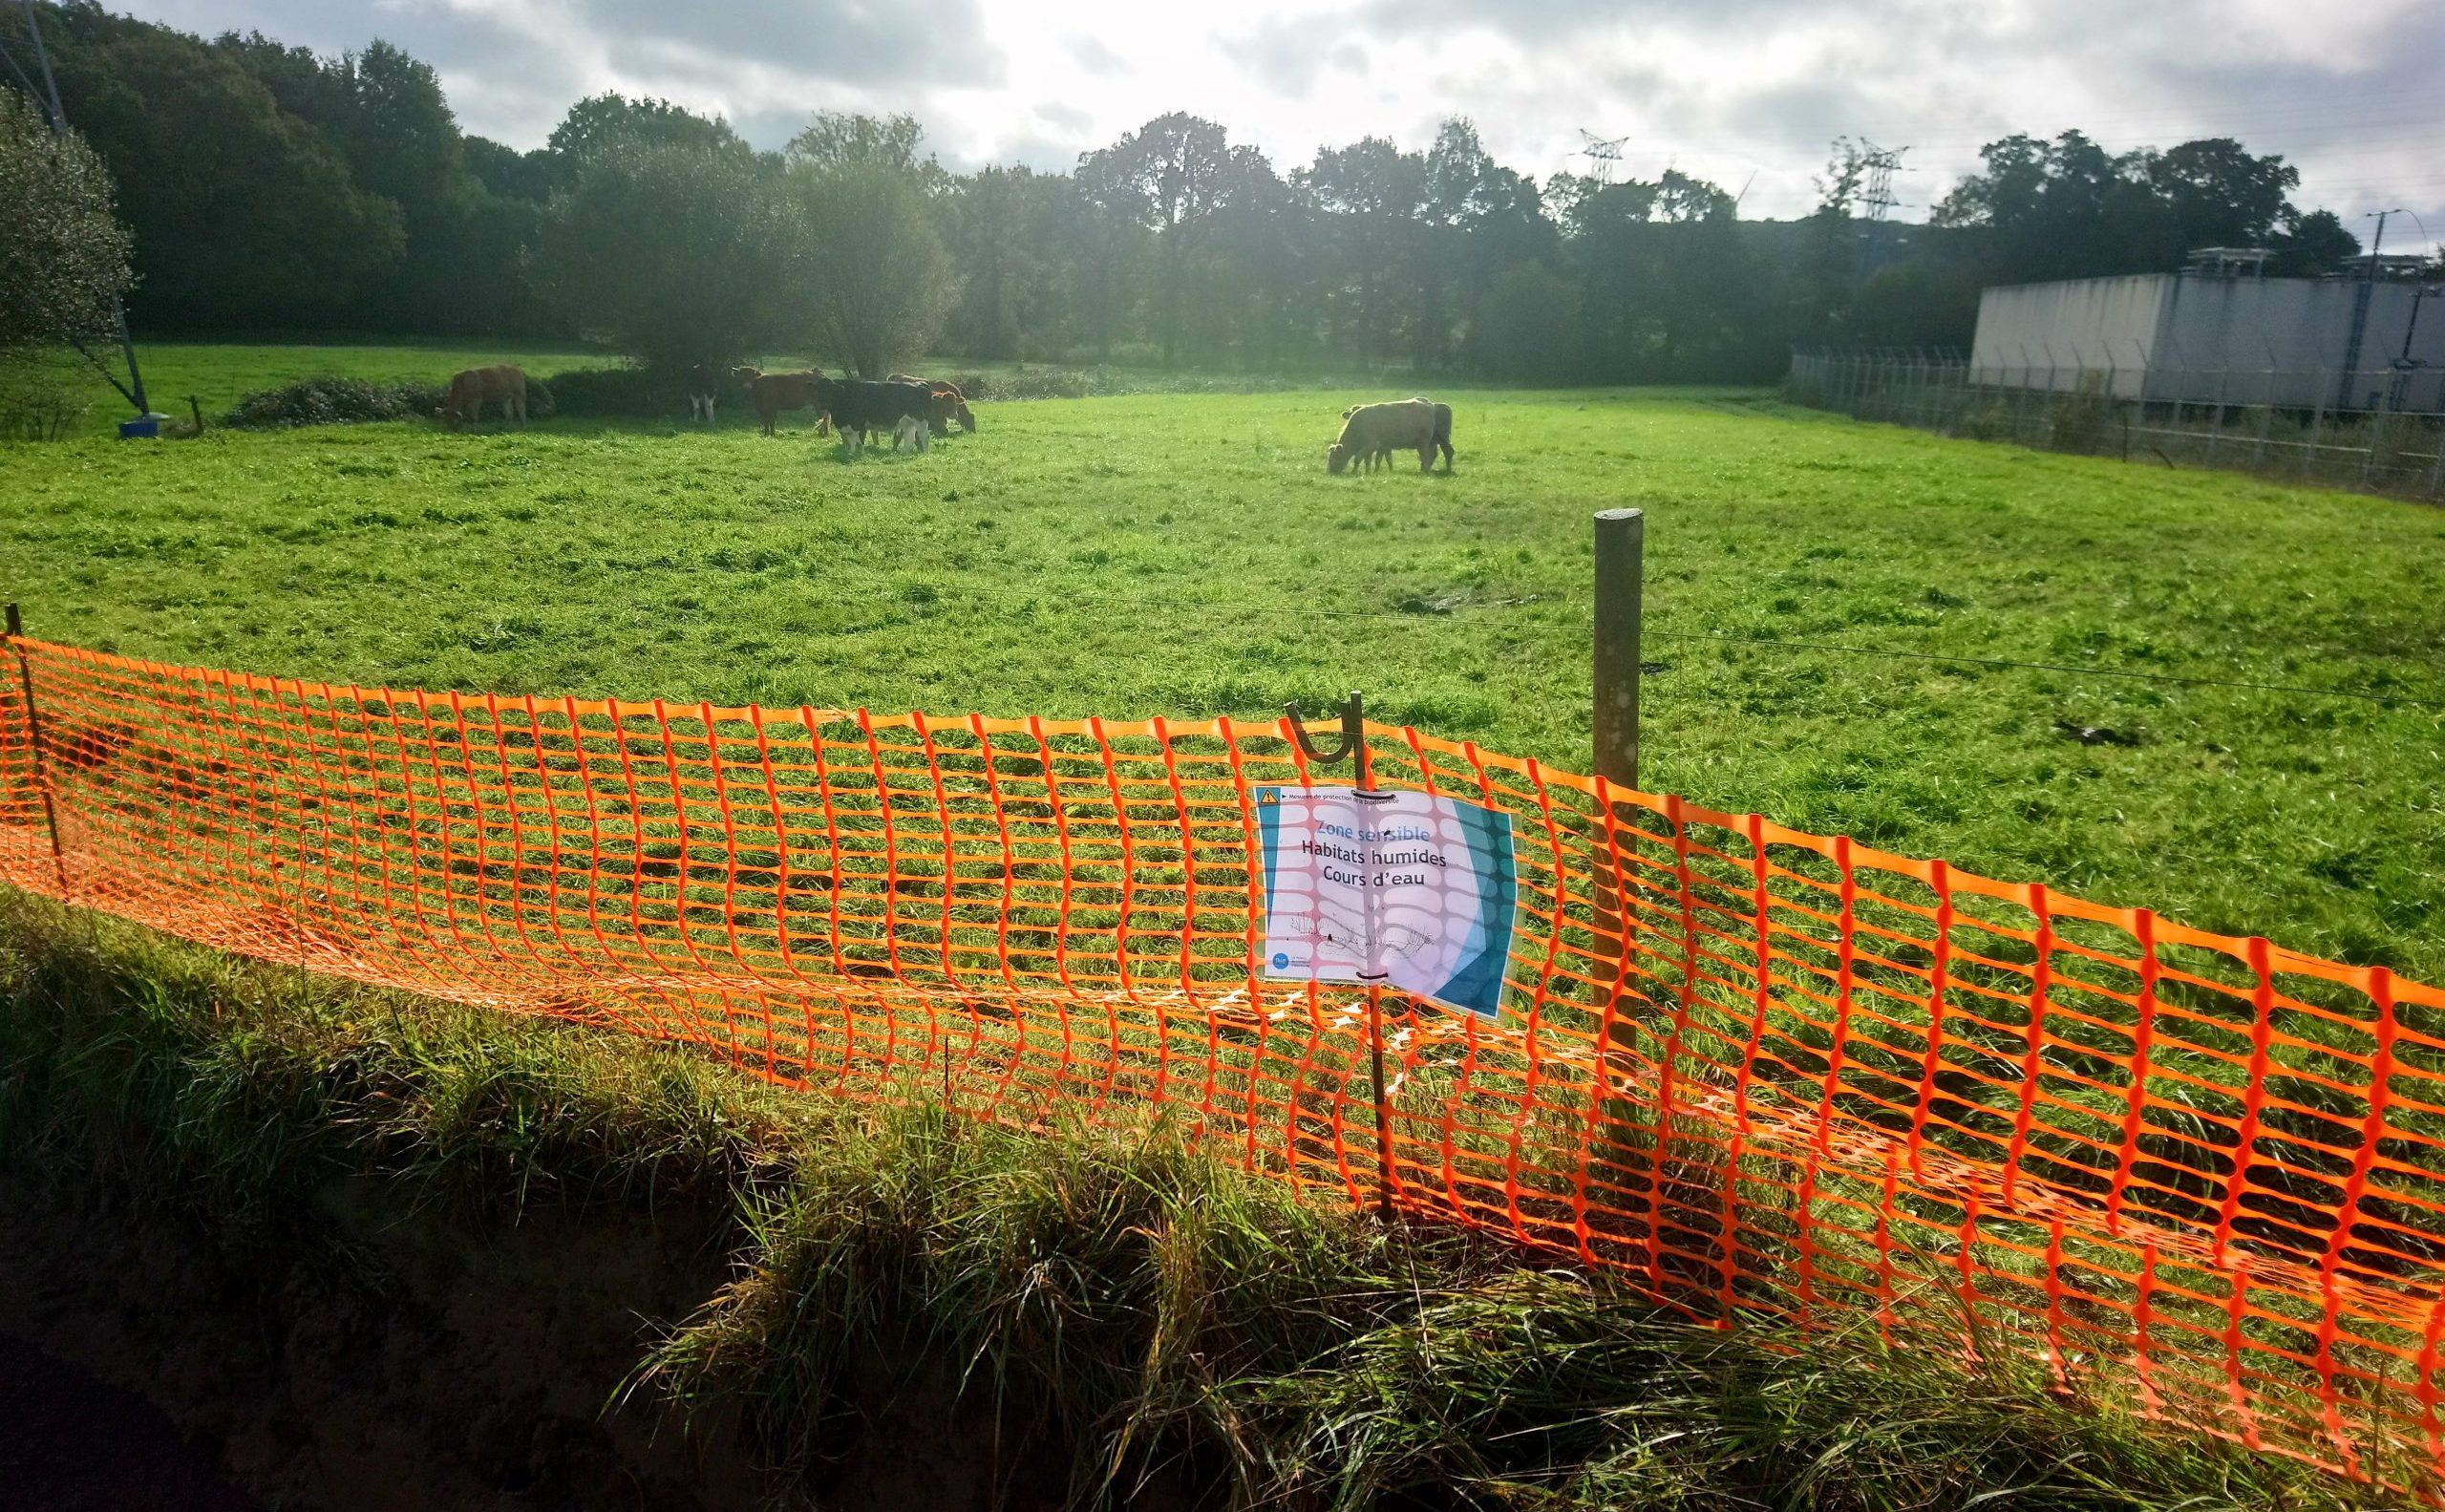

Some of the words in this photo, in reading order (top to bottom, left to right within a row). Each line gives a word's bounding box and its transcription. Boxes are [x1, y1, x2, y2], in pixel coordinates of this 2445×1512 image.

[1316, 820, 1352, 839] Zone
[1358, 825, 1430, 841] sensible
[1302, 841, 1365, 863] Habitats
[1371, 849, 1447, 866] humides
[1324, 866, 1367, 886] Cours
